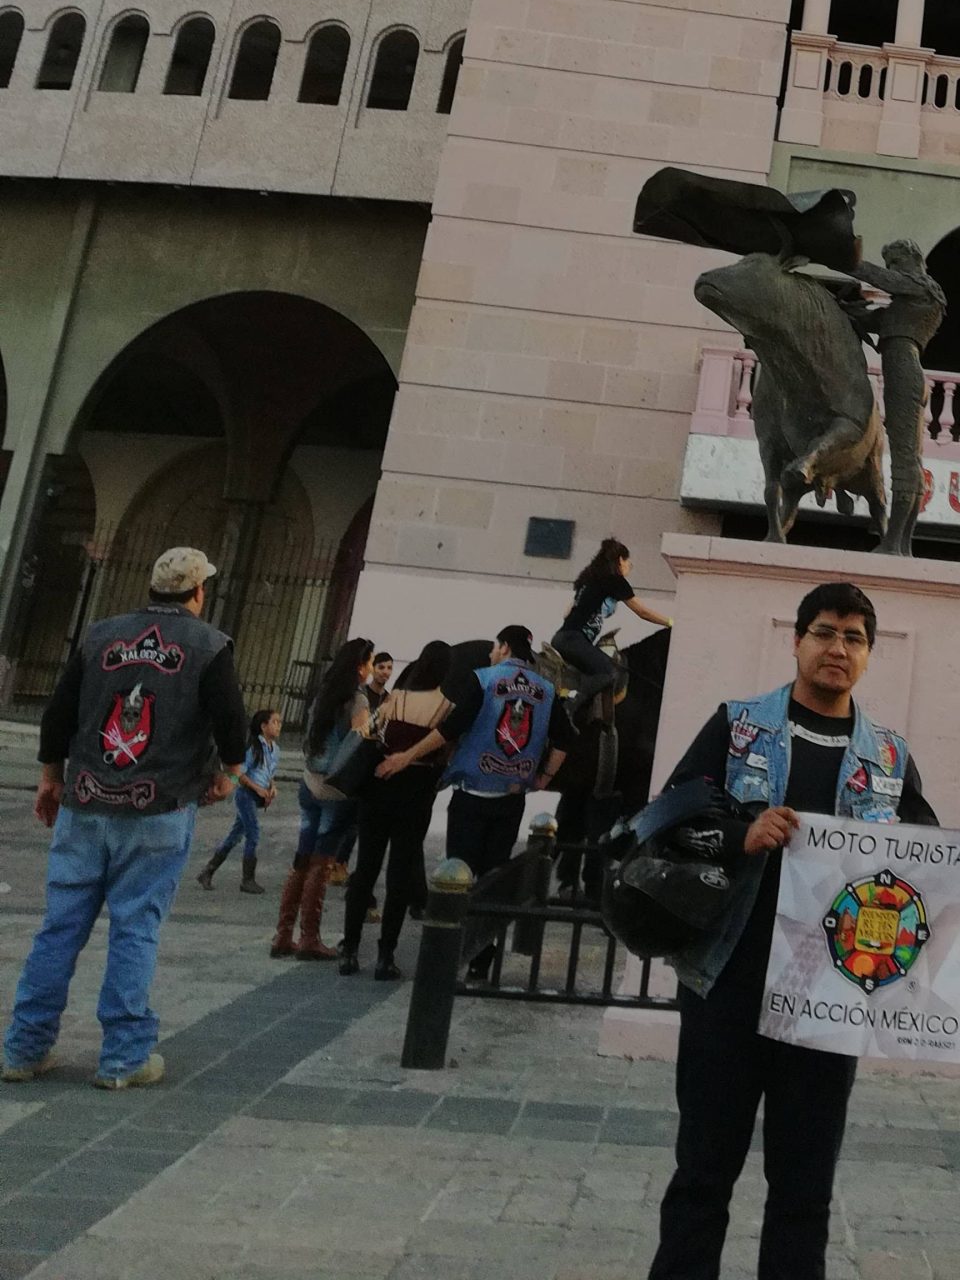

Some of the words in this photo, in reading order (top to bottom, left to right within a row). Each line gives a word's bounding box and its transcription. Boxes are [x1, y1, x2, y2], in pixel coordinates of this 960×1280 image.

[807, 826, 878, 856] MOTO
[880, 873, 892, 884] N
[917, 930, 928, 941] E
[864, 979, 875, 990] S
[769, 993, 797, 1015] EN
[800, 1001, 876, 1029] ACCIÓN
[881, 1006, 960, 1035] MÉXICO
